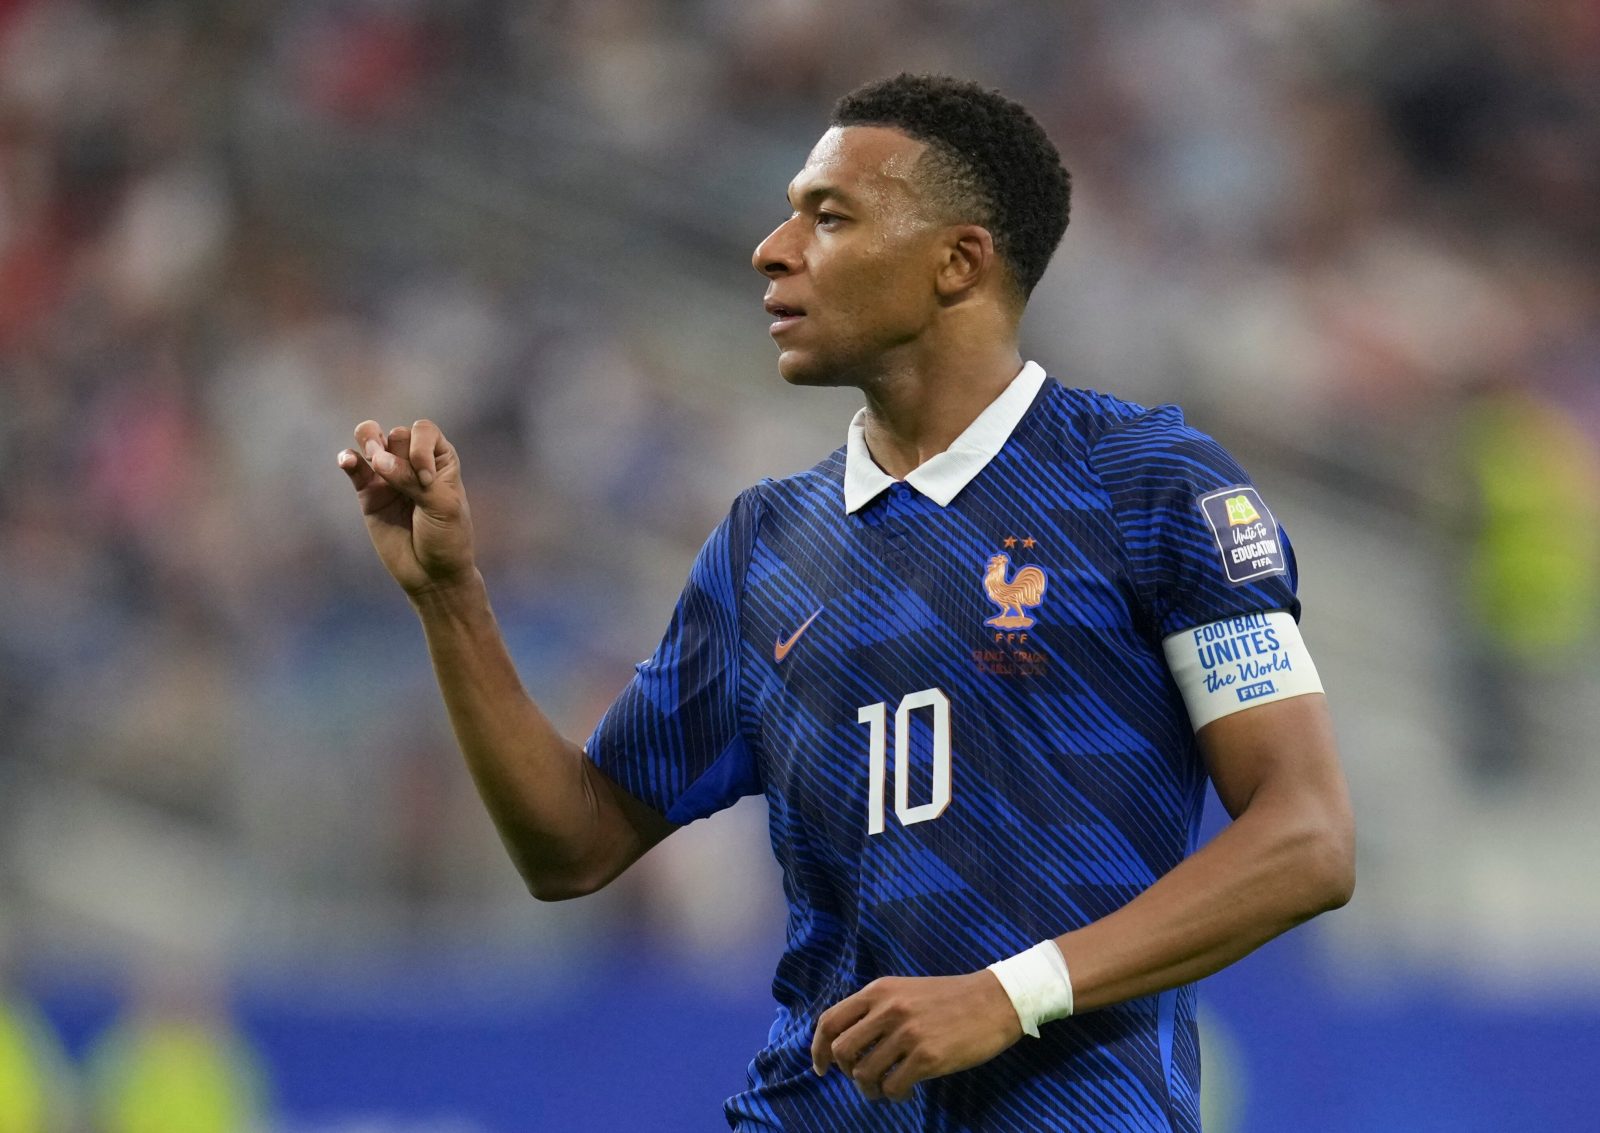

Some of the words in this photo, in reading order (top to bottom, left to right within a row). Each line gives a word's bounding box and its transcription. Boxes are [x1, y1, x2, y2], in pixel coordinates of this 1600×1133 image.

[1232, 526, 1256, 545] Unite
[1251, 557, 1272, 569] FIFA
[1193, 611, 1272, 646] FOOTBALL
[1198, 628, 1280, 670] UNITES
[1203, 670, 1236, 693] the
[1237, 651, 1292, 682] World
[1240, 682, 1272, 700] FIFA
[858, 687, 952, 835] 10
